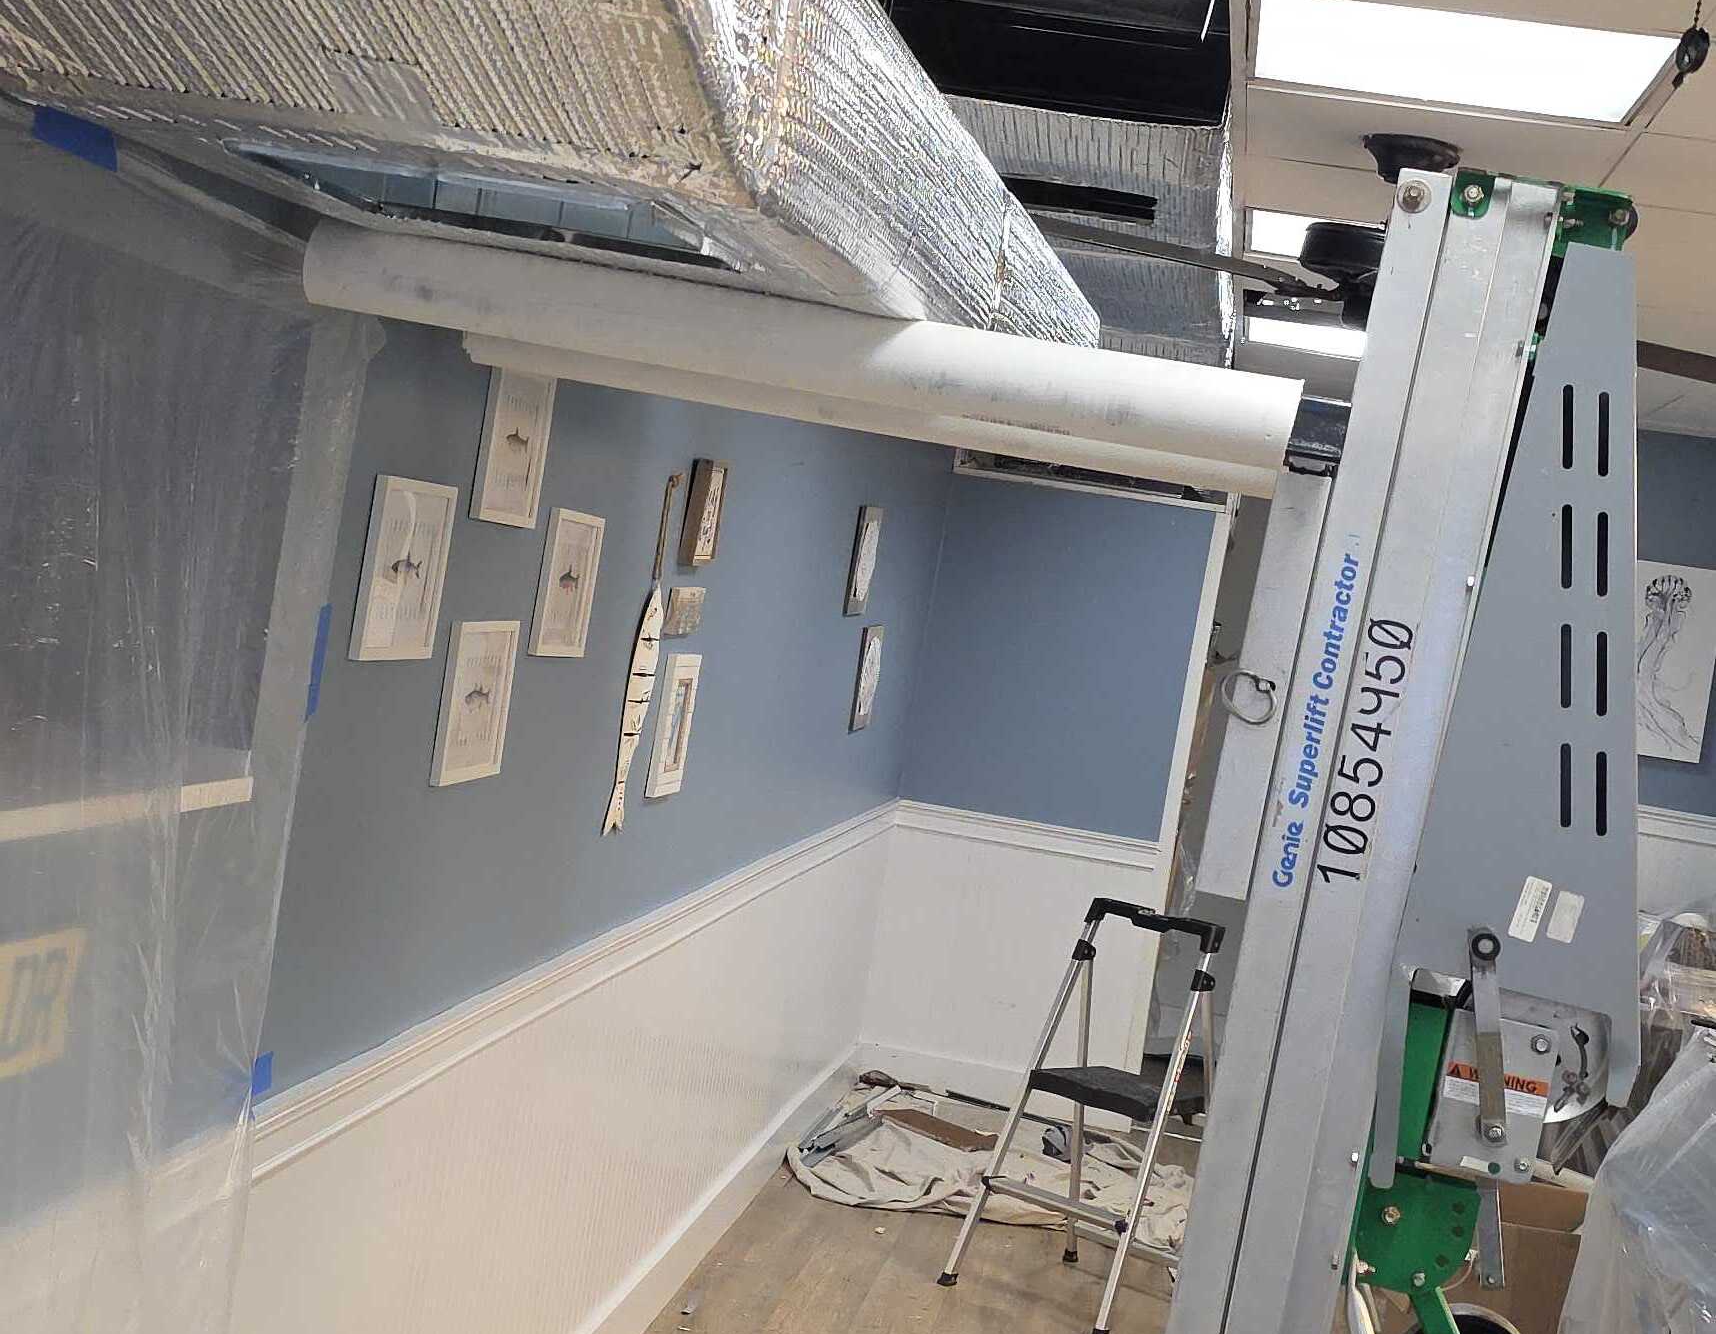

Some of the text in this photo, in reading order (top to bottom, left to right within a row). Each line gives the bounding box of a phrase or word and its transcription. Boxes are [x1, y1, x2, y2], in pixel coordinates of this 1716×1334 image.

[1272, 553, 1361, 889] Genie Superlift Contractor
[1469, 1066, 1538, 1094] WNING
